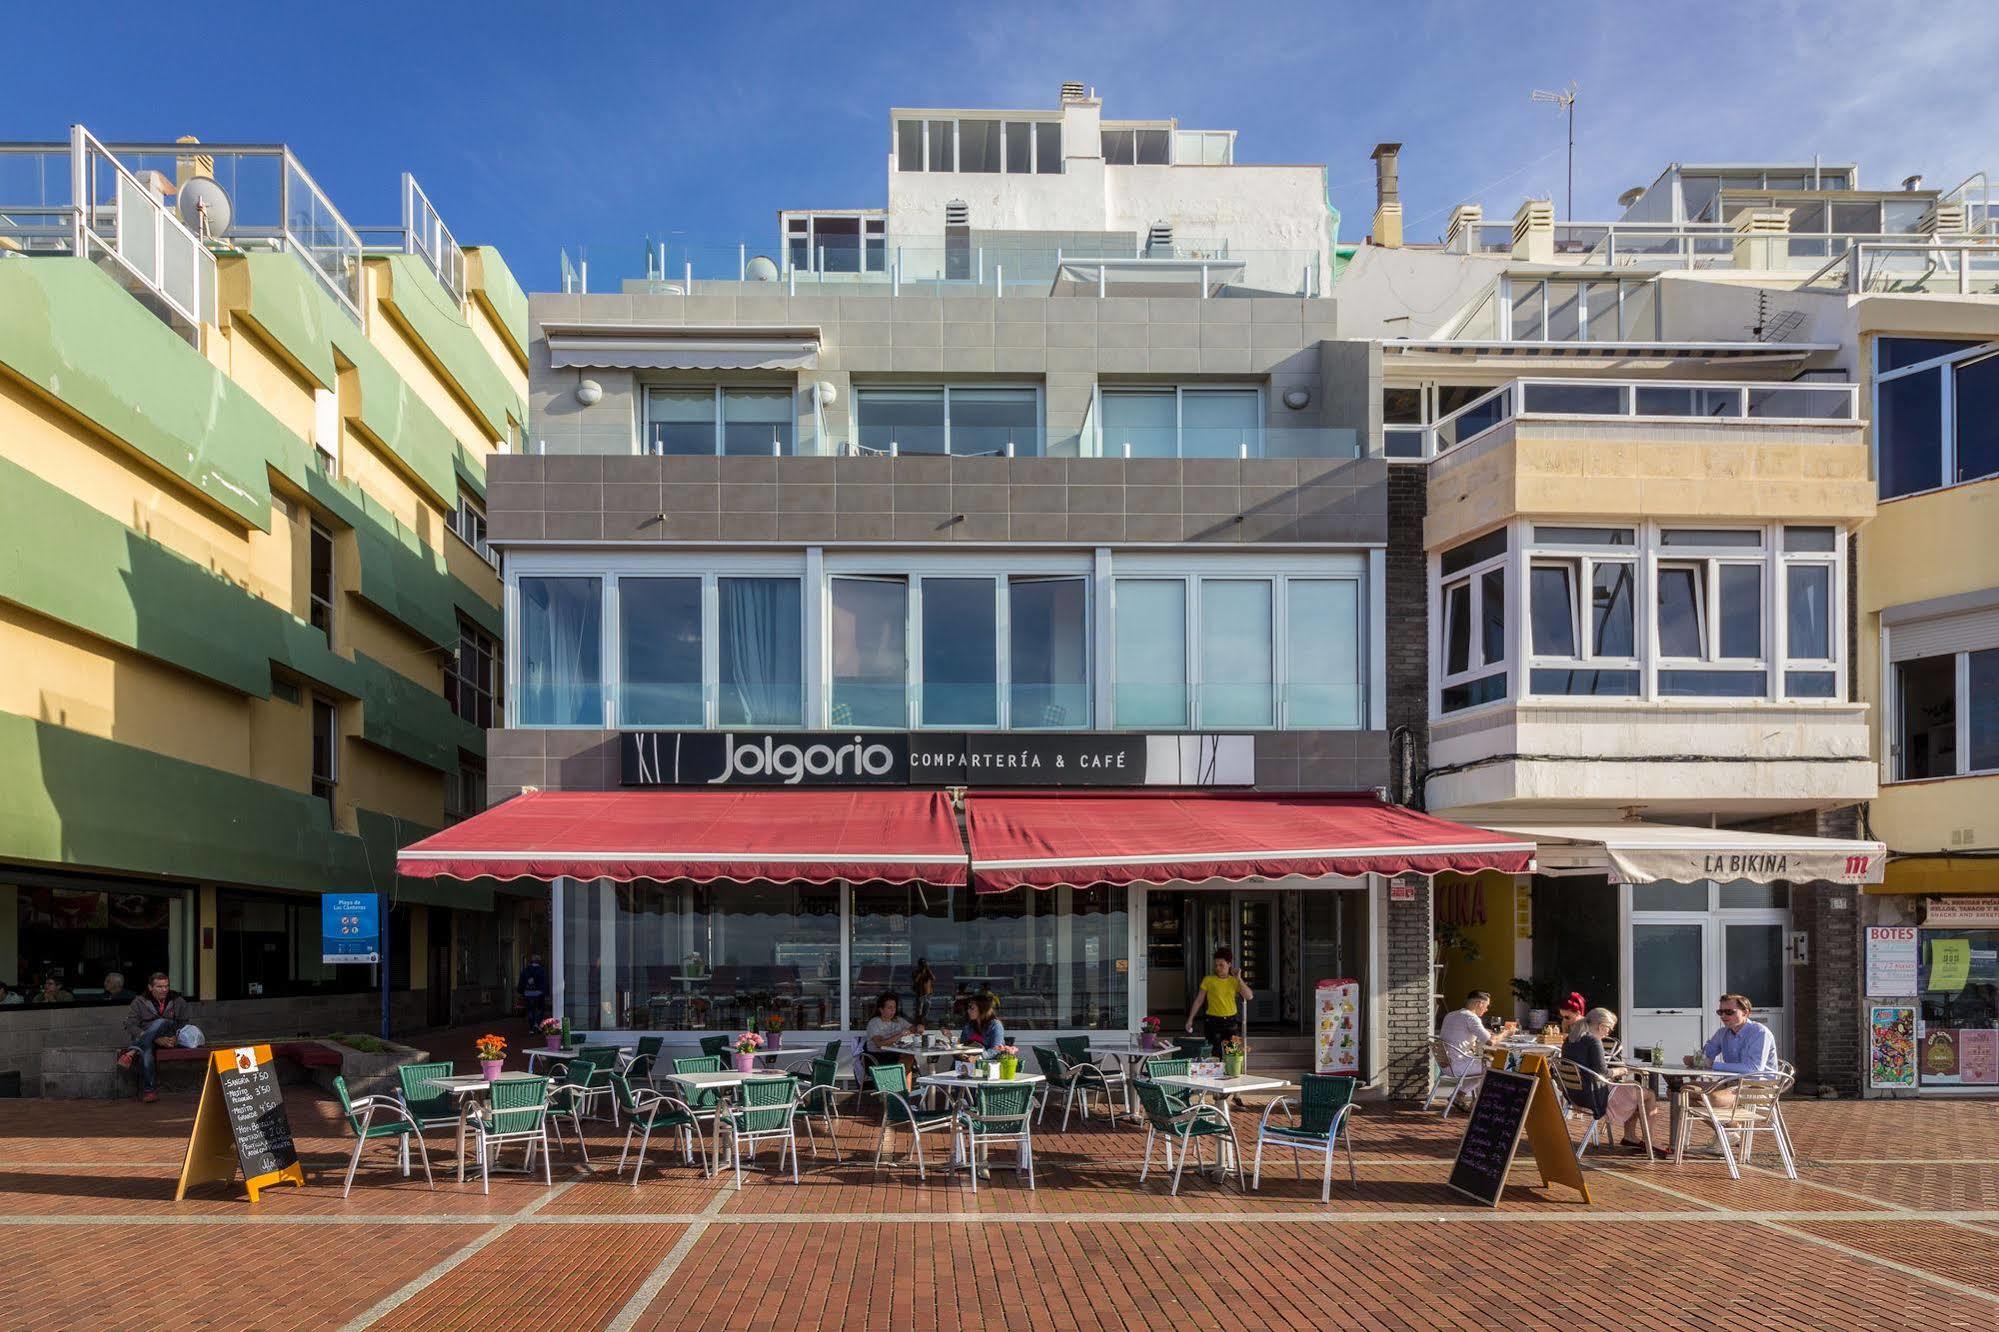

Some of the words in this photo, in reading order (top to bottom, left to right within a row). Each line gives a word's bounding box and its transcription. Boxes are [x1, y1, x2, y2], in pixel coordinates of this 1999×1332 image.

[708, 733, 894, 785] Jolgorio
[910, 750, 1041, 769] COMPARTERÍA
[1056, 754, 1066, 769] &
[1080, 750, 1126, 769] CAFÉ
[1704, 855, 1723, 873] LA
[1731, 855, 1788, 873] BIKINA
[1871, 928, 1914, 940] BOTES
